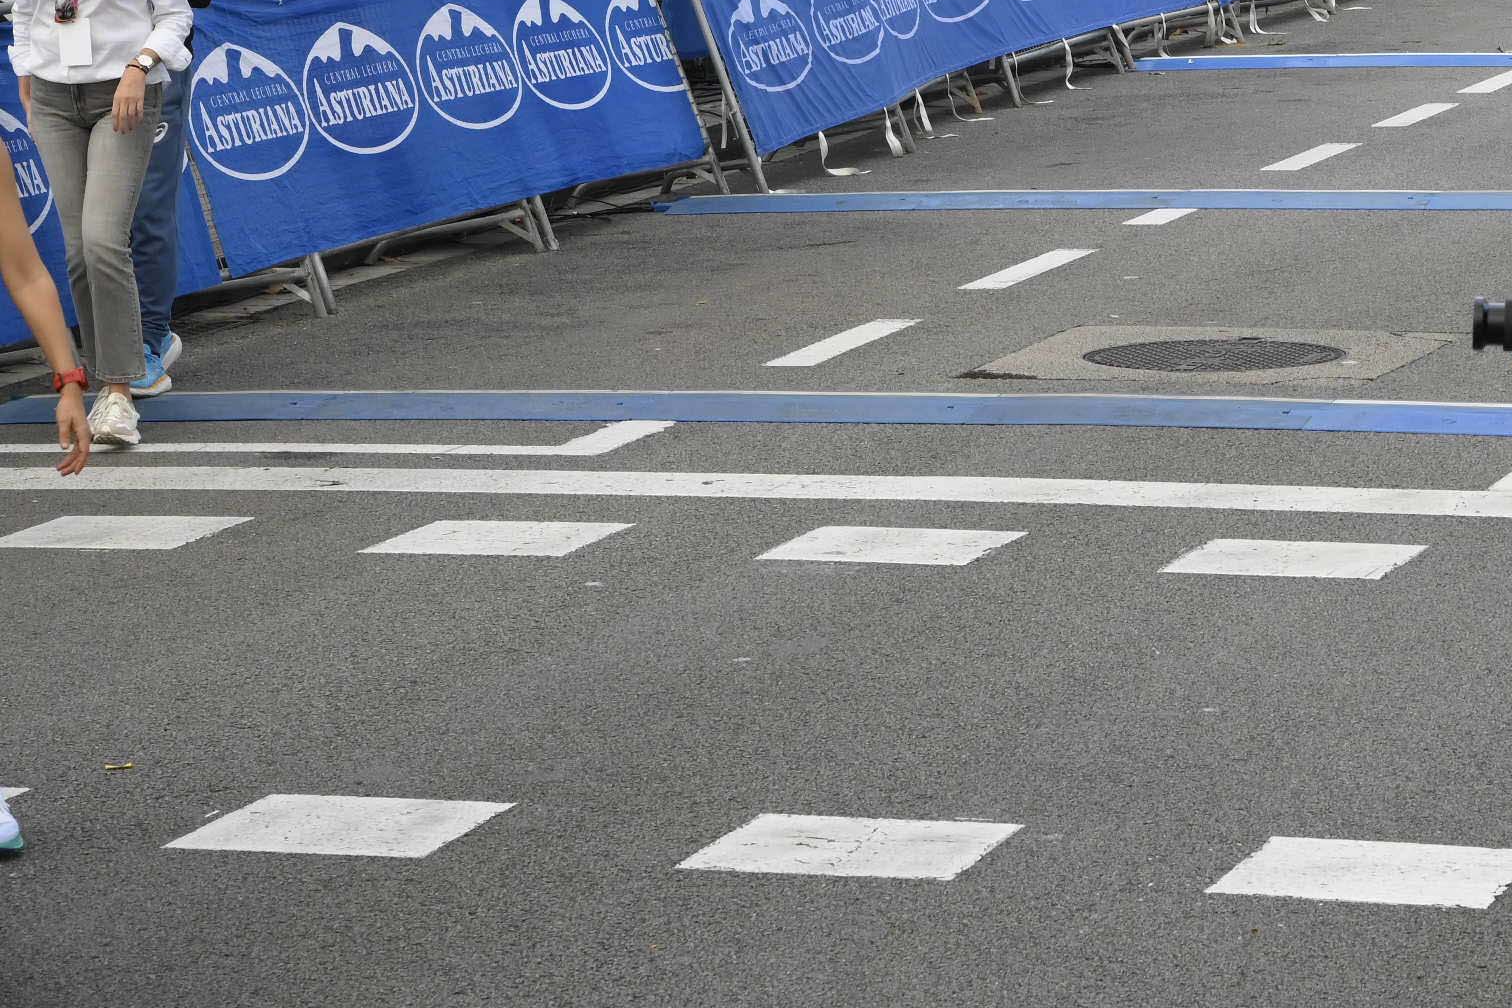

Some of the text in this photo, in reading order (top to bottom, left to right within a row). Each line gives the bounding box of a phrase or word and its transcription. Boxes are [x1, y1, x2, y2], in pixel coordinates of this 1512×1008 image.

[530, 27, 590, 47] CENTRAL LECHERA
[624, 17, 656, 31] CENTRAL
[436, 41, 502, 63] CENTRAL LECHERA
[522, 40, 606, 84] ASTURIANA
[615, 25, 676, 68] ASTUR
[324, 59, 398, 85] CENTRAL LECHERA
[427, 55, 517, 103] ASTURIANA
[211, 83, 288, 108] CENTRAL LECHERA
[314, 77, 414, 128] ASTURIANA
[200, 101, 304, 154] ASTURIANA
